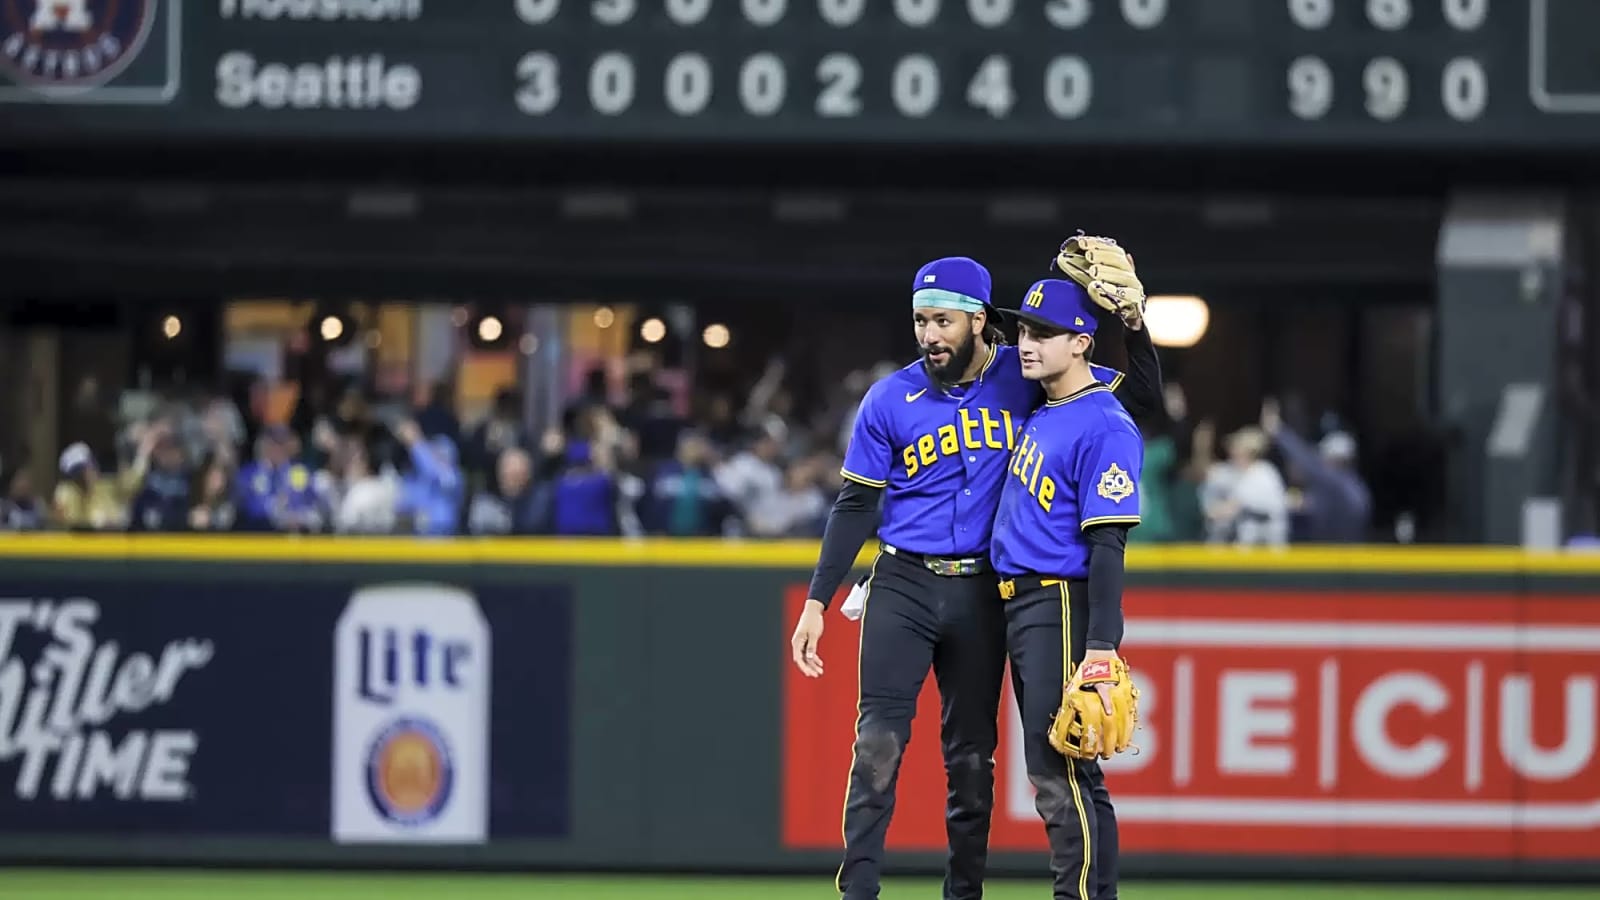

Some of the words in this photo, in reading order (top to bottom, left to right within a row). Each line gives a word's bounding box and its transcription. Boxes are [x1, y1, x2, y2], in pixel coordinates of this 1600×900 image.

[216, 51, 422, 110] Seattle
[516, 53, 560, 114] 3
[590, 53, 635, 114] 0
[665, 54, 711, 115] 0
[739, 54, 786, 115] 0
[816, 55, 861, 117] 2
[893, 56, 940, 116] 0
[967, 57, 1014, 117] 4
[1046, 57, 1092, 118] 0
[1288, 57, 1332, 118] 9
[1365, 59, 1407, 118] 9
[1442, 58, 1487, 120] 0
[903, 407, 1022, 479] seattl
[1009, 433, 1056, 513] ttle
[1104, 474, 1127, 490] 50
[357, 627, 472, 705] Lite
[15, 730, 199, 800] TIME
